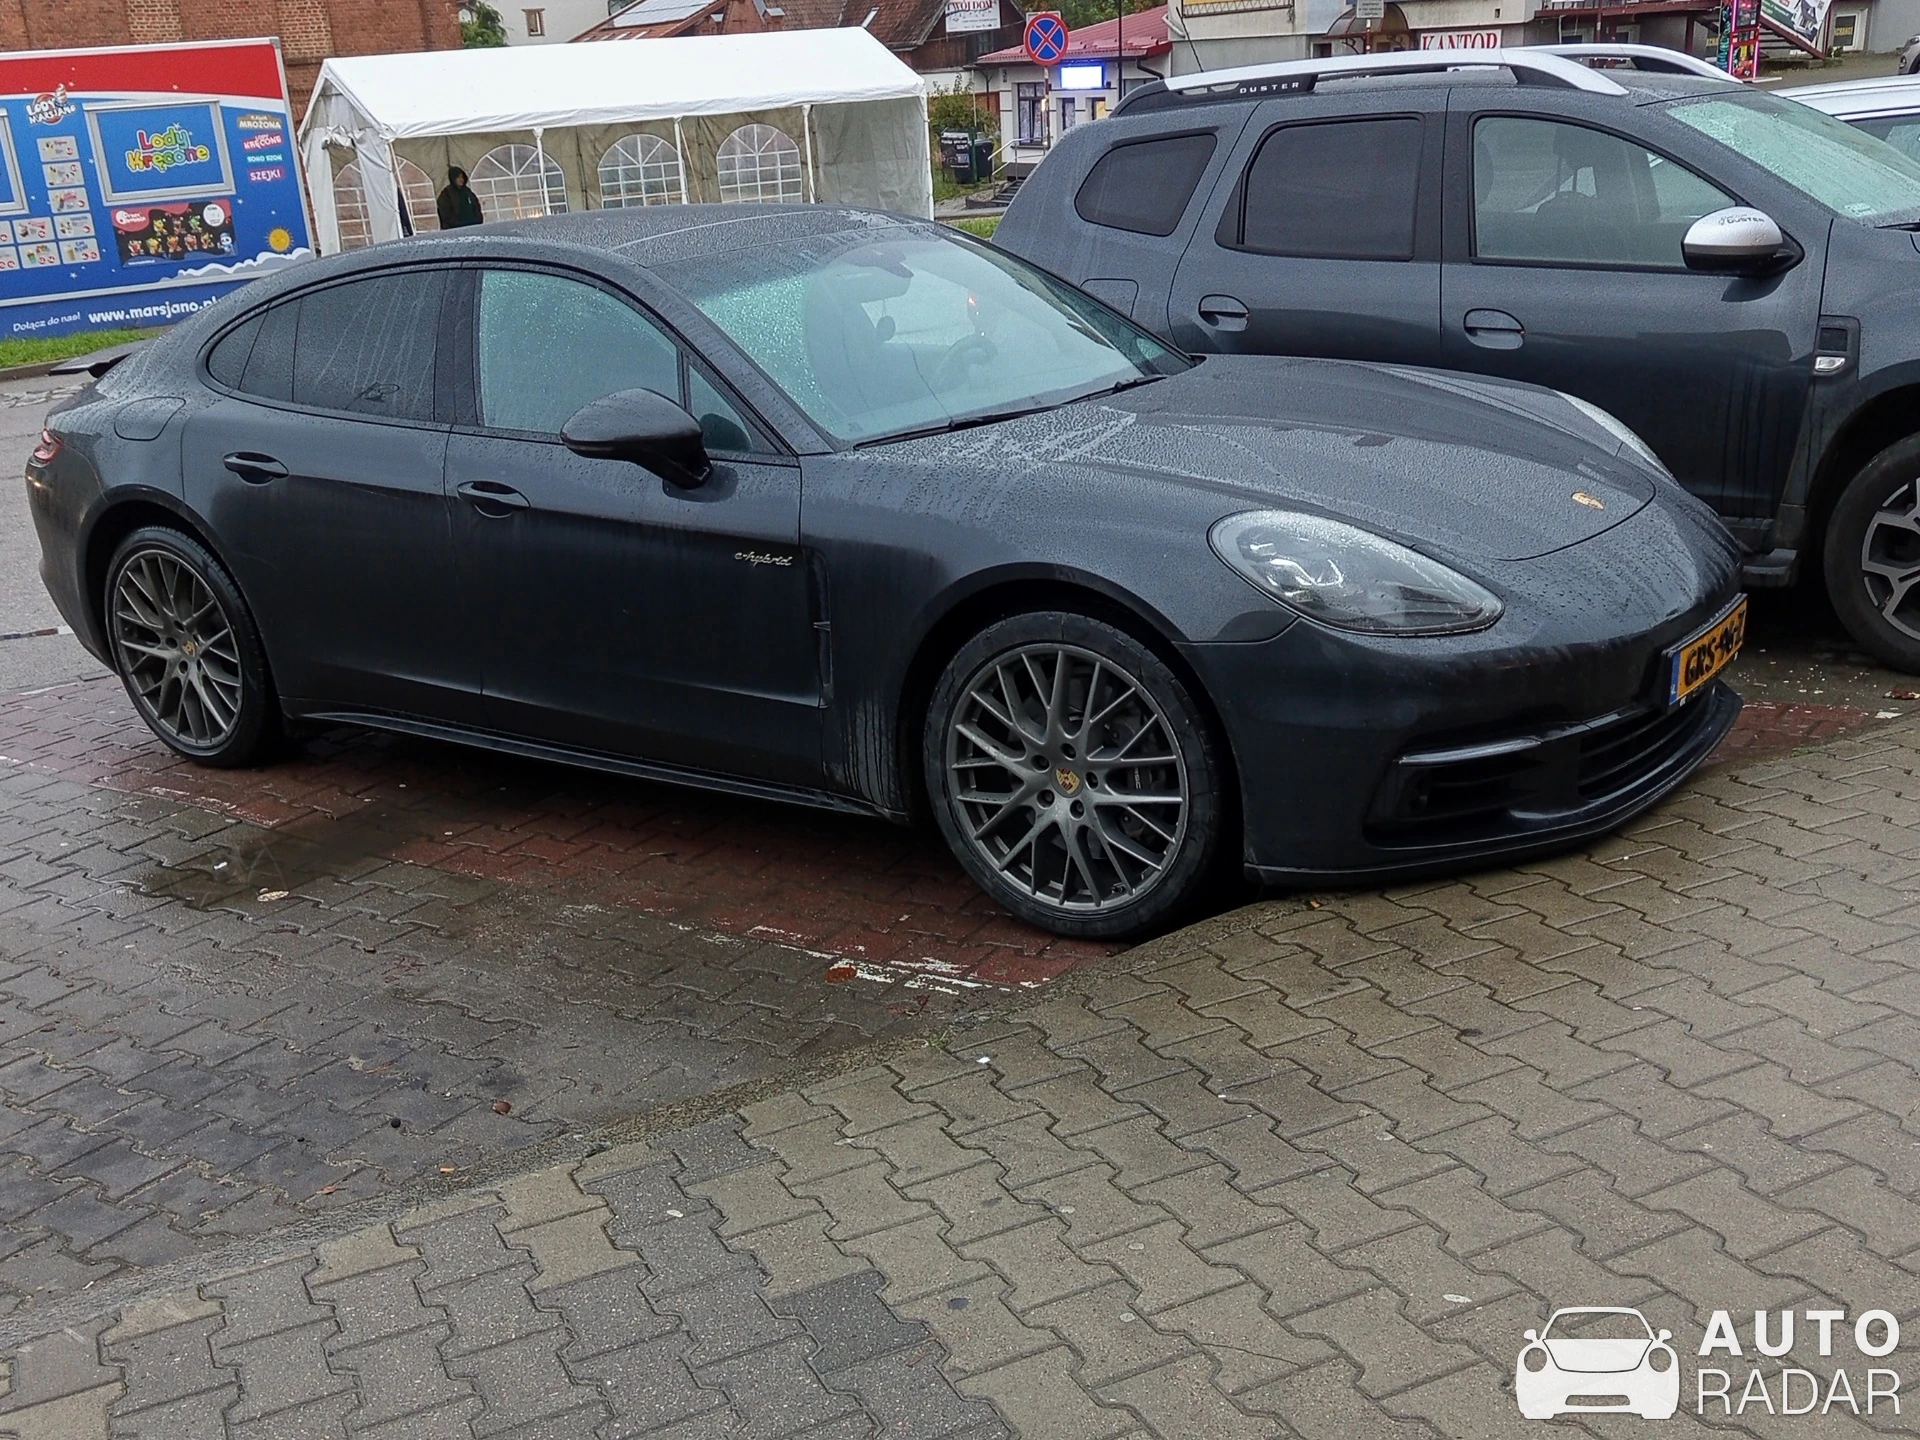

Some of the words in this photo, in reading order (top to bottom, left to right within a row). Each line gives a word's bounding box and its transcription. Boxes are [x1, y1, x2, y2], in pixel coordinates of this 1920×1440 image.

[1239, 82, 1299, 94] DUSTER
[26, 97, 56, 115] LODY
[29, 104, 76, 124] MARSJANO
[137, 127, 190, 150] Lody
[125, 146, 209, 172] Kręcone
[250, 169, 281, 181] SZEJKI
[13, 321, 46, 332] Dołącz
[47, 316, 60, 326] do
[60, 311, 81, 323] nas!
